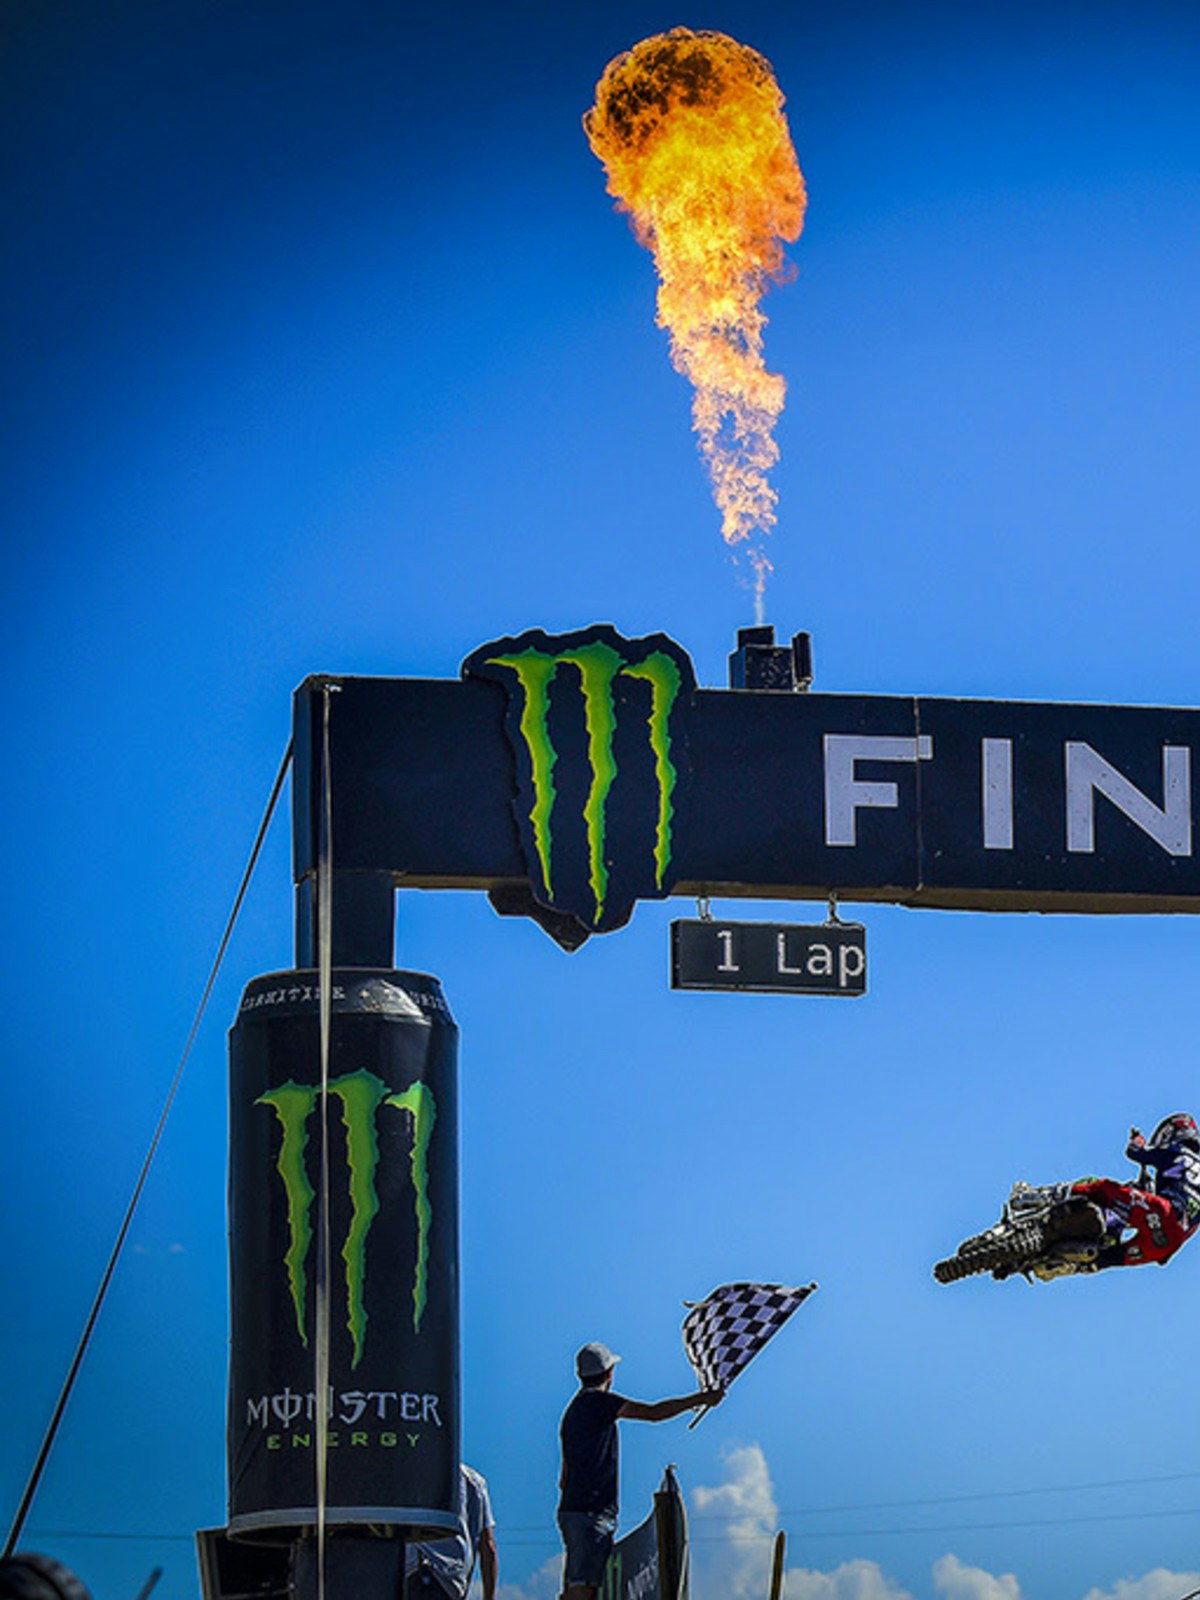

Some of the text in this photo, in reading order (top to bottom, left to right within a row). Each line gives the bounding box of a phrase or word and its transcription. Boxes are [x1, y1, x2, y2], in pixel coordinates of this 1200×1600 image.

[716, 929, 866, 987] 1 Lap
[246, 1386, 442, 1429] MONSTER
[266, 1431, 421, 1450] ENERGY
